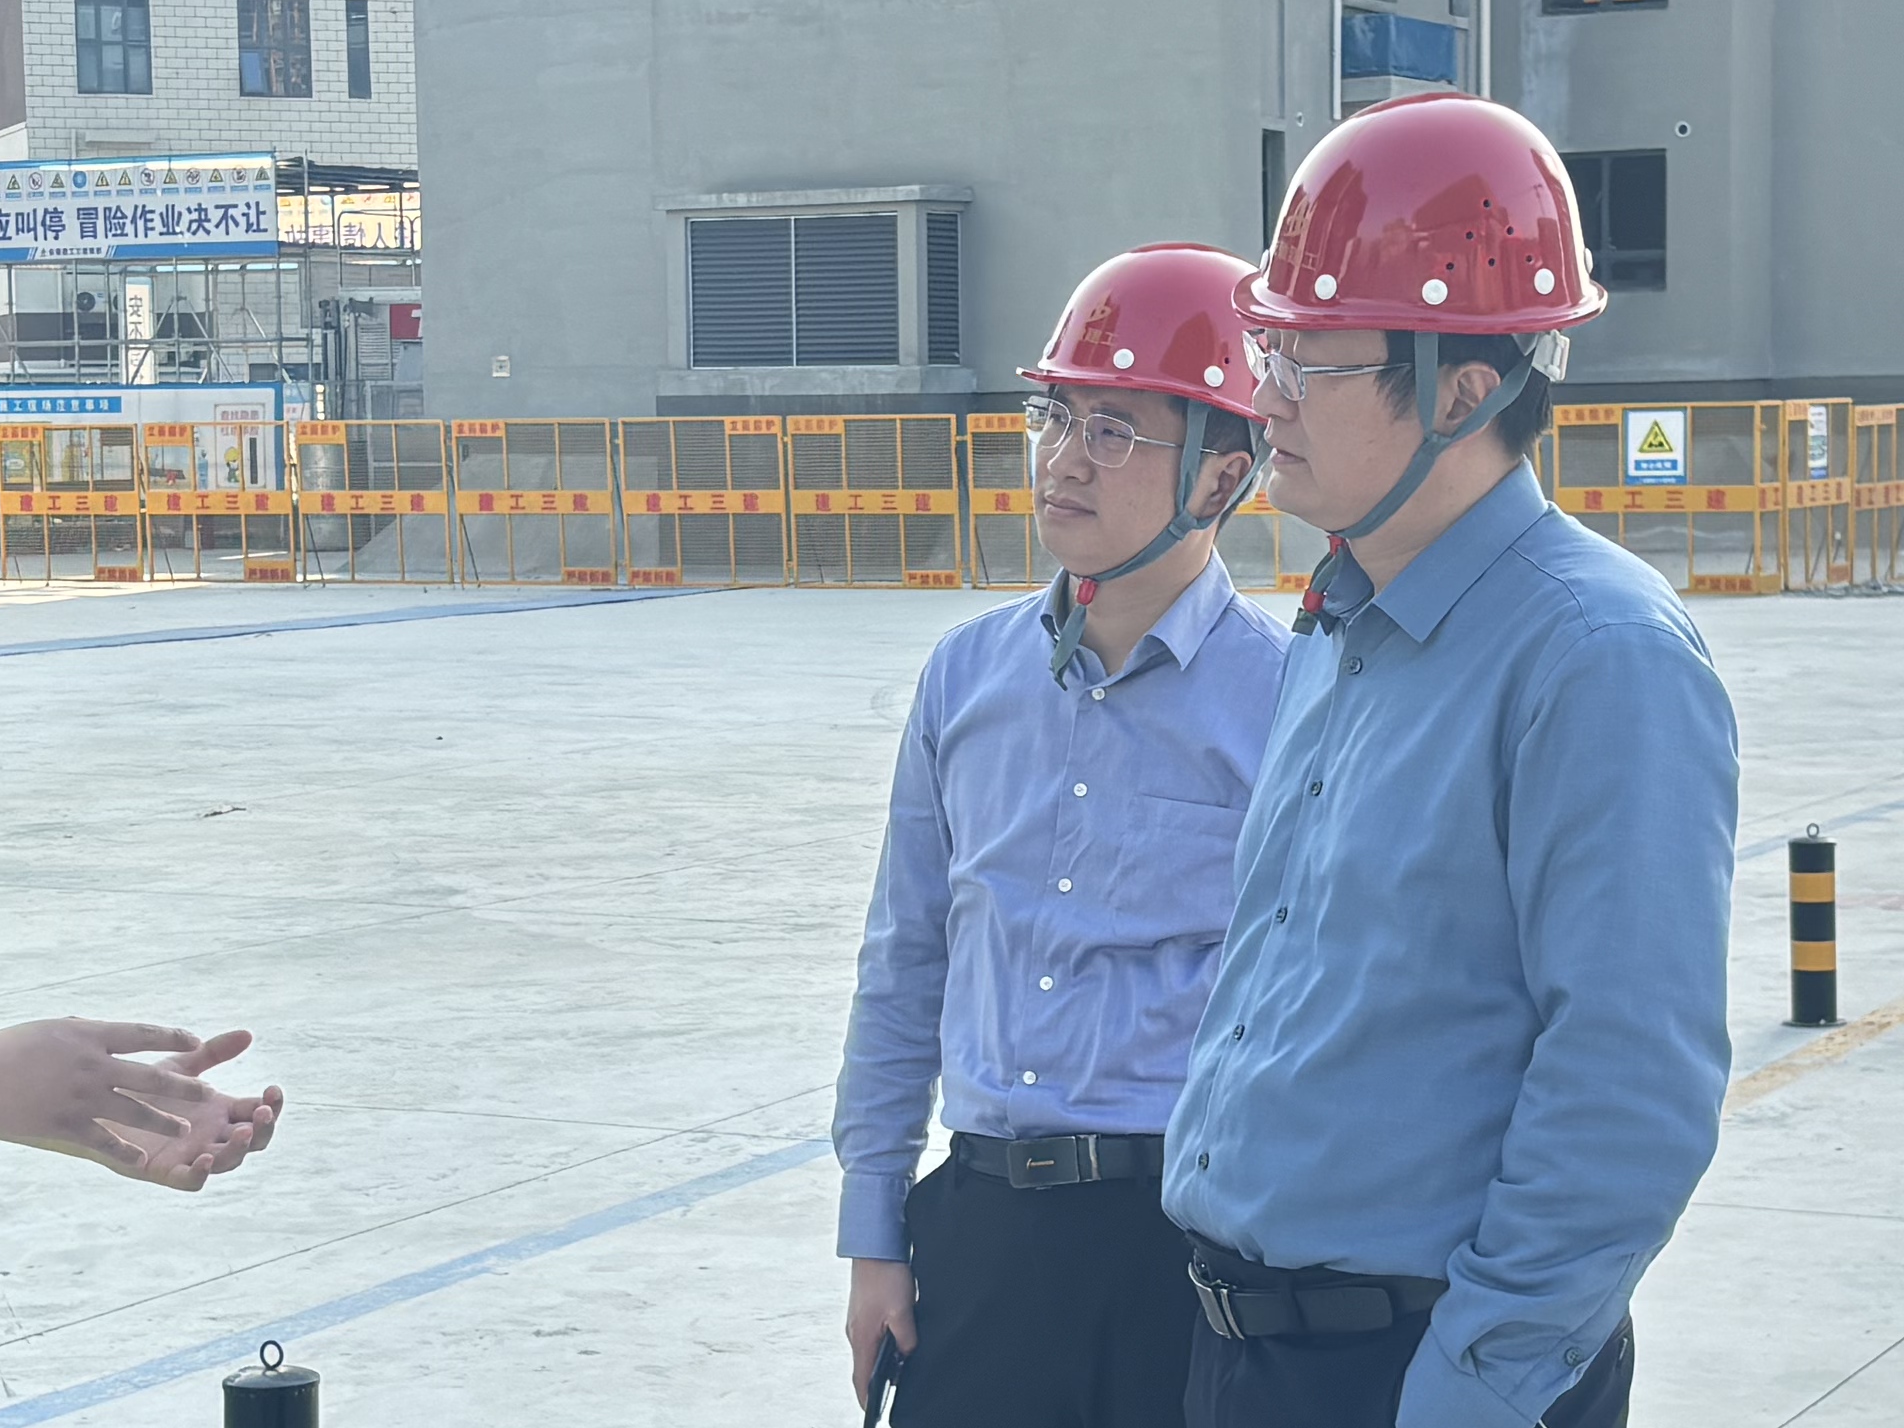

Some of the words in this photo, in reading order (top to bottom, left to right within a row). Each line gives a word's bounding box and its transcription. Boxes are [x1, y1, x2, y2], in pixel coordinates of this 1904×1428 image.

[75, 200, 269, 240] 冒险作业决不让
[19, 493, 119, 512] 建工三建
[166, 493, 271, 512] 建工三建
[320, 493, 426, 512] 建工三建
[478, 493, 590, 512] 建工三建
[646, 492, 759, 512] 建工三建
[814, 492, 932, 512] 建工三建
[1584, 489, 1728, 510] 建工三建
